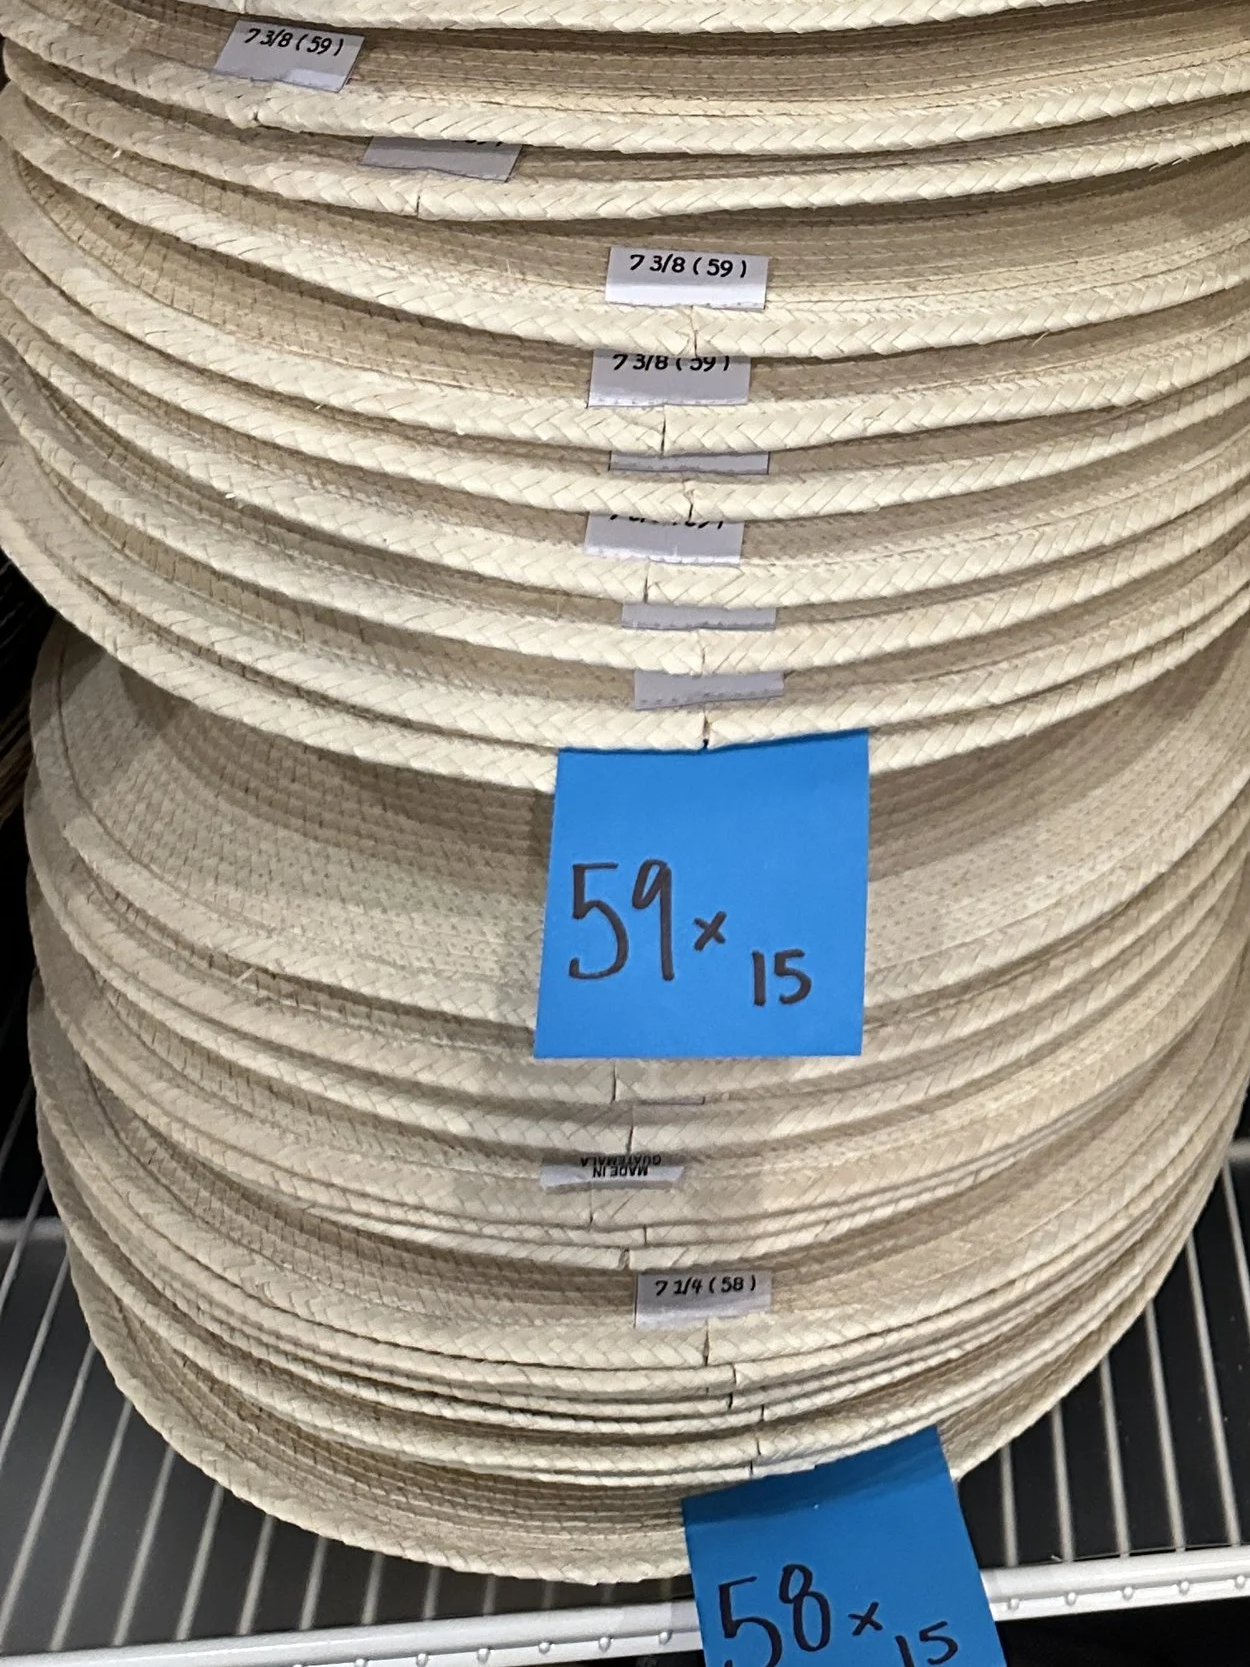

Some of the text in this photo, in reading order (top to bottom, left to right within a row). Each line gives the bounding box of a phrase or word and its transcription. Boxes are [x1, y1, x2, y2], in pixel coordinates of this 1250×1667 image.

[244, 28, 344, 56] 7 3/8 (59)
[629, 253, 747, 278] 7 3/8 (59)
[612, 354, 628, 370] 7
[632, 354, 669, 371] 3/8
[567, 858, 675, 982] 59
[751, 948, 812, 1007] 15
[592, 1165, 649, 1178] MADE IN
[655, 1274, 756, 1296] 7 1/4 (58)
[718, 1563, 831, 1667] 58
